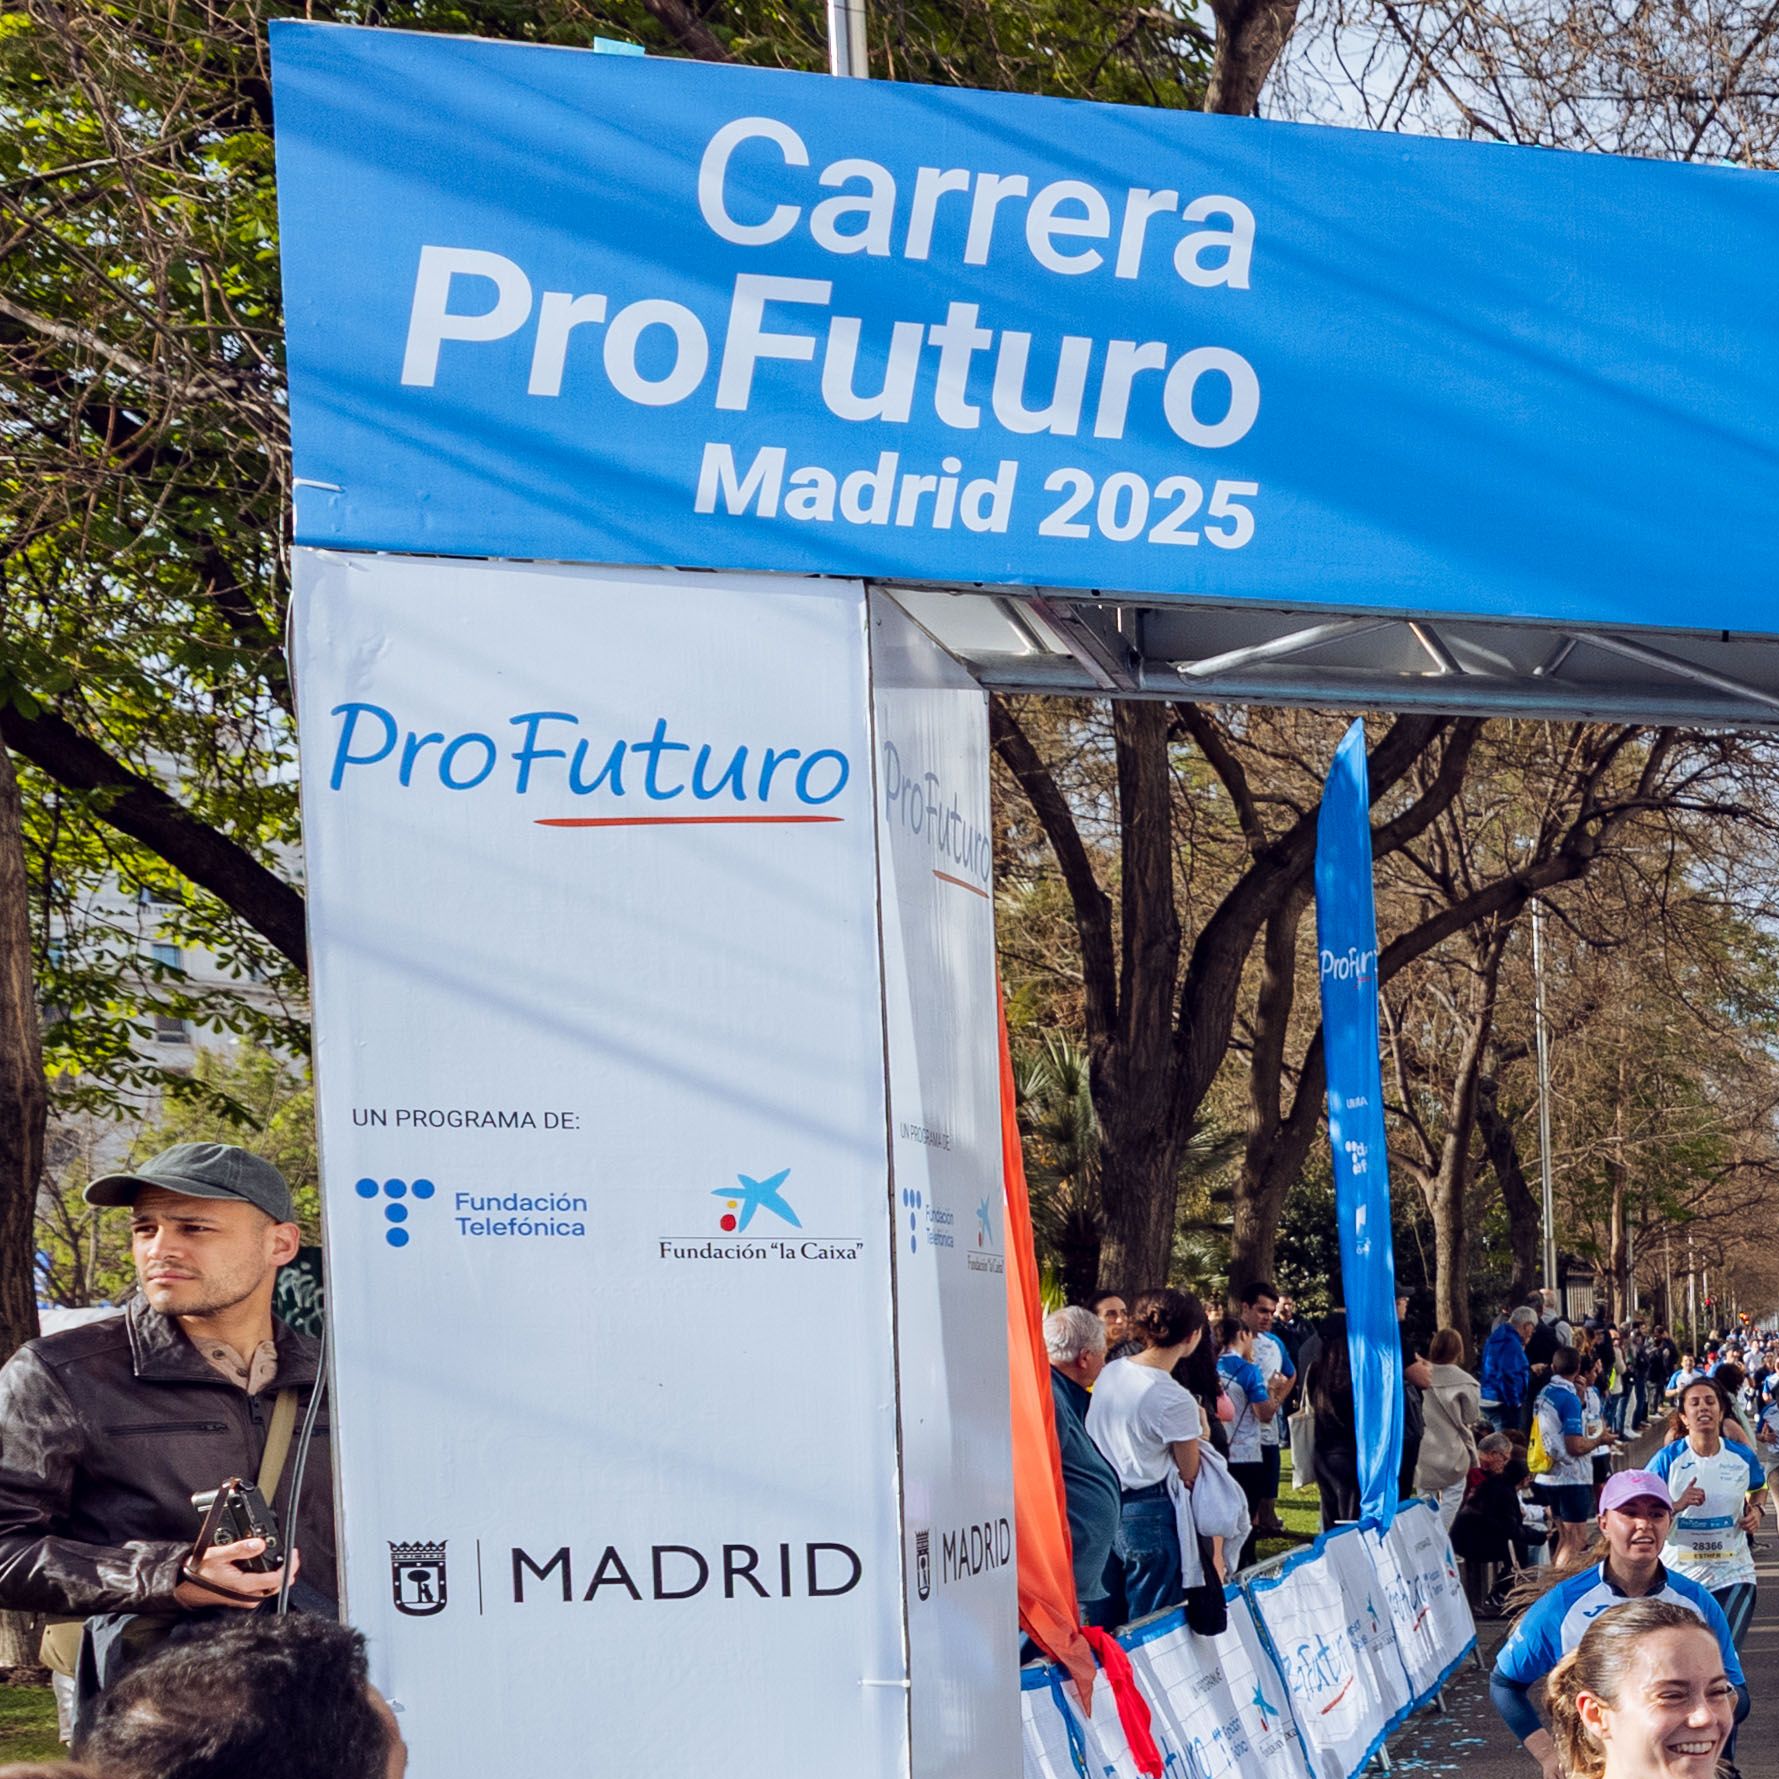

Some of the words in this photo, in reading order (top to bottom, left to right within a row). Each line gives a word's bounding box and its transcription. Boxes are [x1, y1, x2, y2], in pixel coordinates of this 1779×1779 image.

[699, 117, 1255, 288] Carrera
[402, 245, 1260, 447] ProFuturo
[694, 443, 1019, 532] Madrid
[1039, 467, 1259, 548] 2025
[331, 702, 850, 804] ProFuturo
[884, 741, 990, 882] ProFuturo
[353, 1109, 387, 1126] UN
[396, 1110, 536, 1128] PROGRAMA
[544, 1112, 580, 1129] DE:
[910, 1124, 942, 1150] PROGRAMA
[455, 1192, 588, 1211] Fundación
[455, 1217, 586, 1236] Telefónica
[660, 1241, 767, 1260] Fundación
[512, 1542, 862, 1603] MADRID
[943, 1518, 1011, 1584] MADRID
